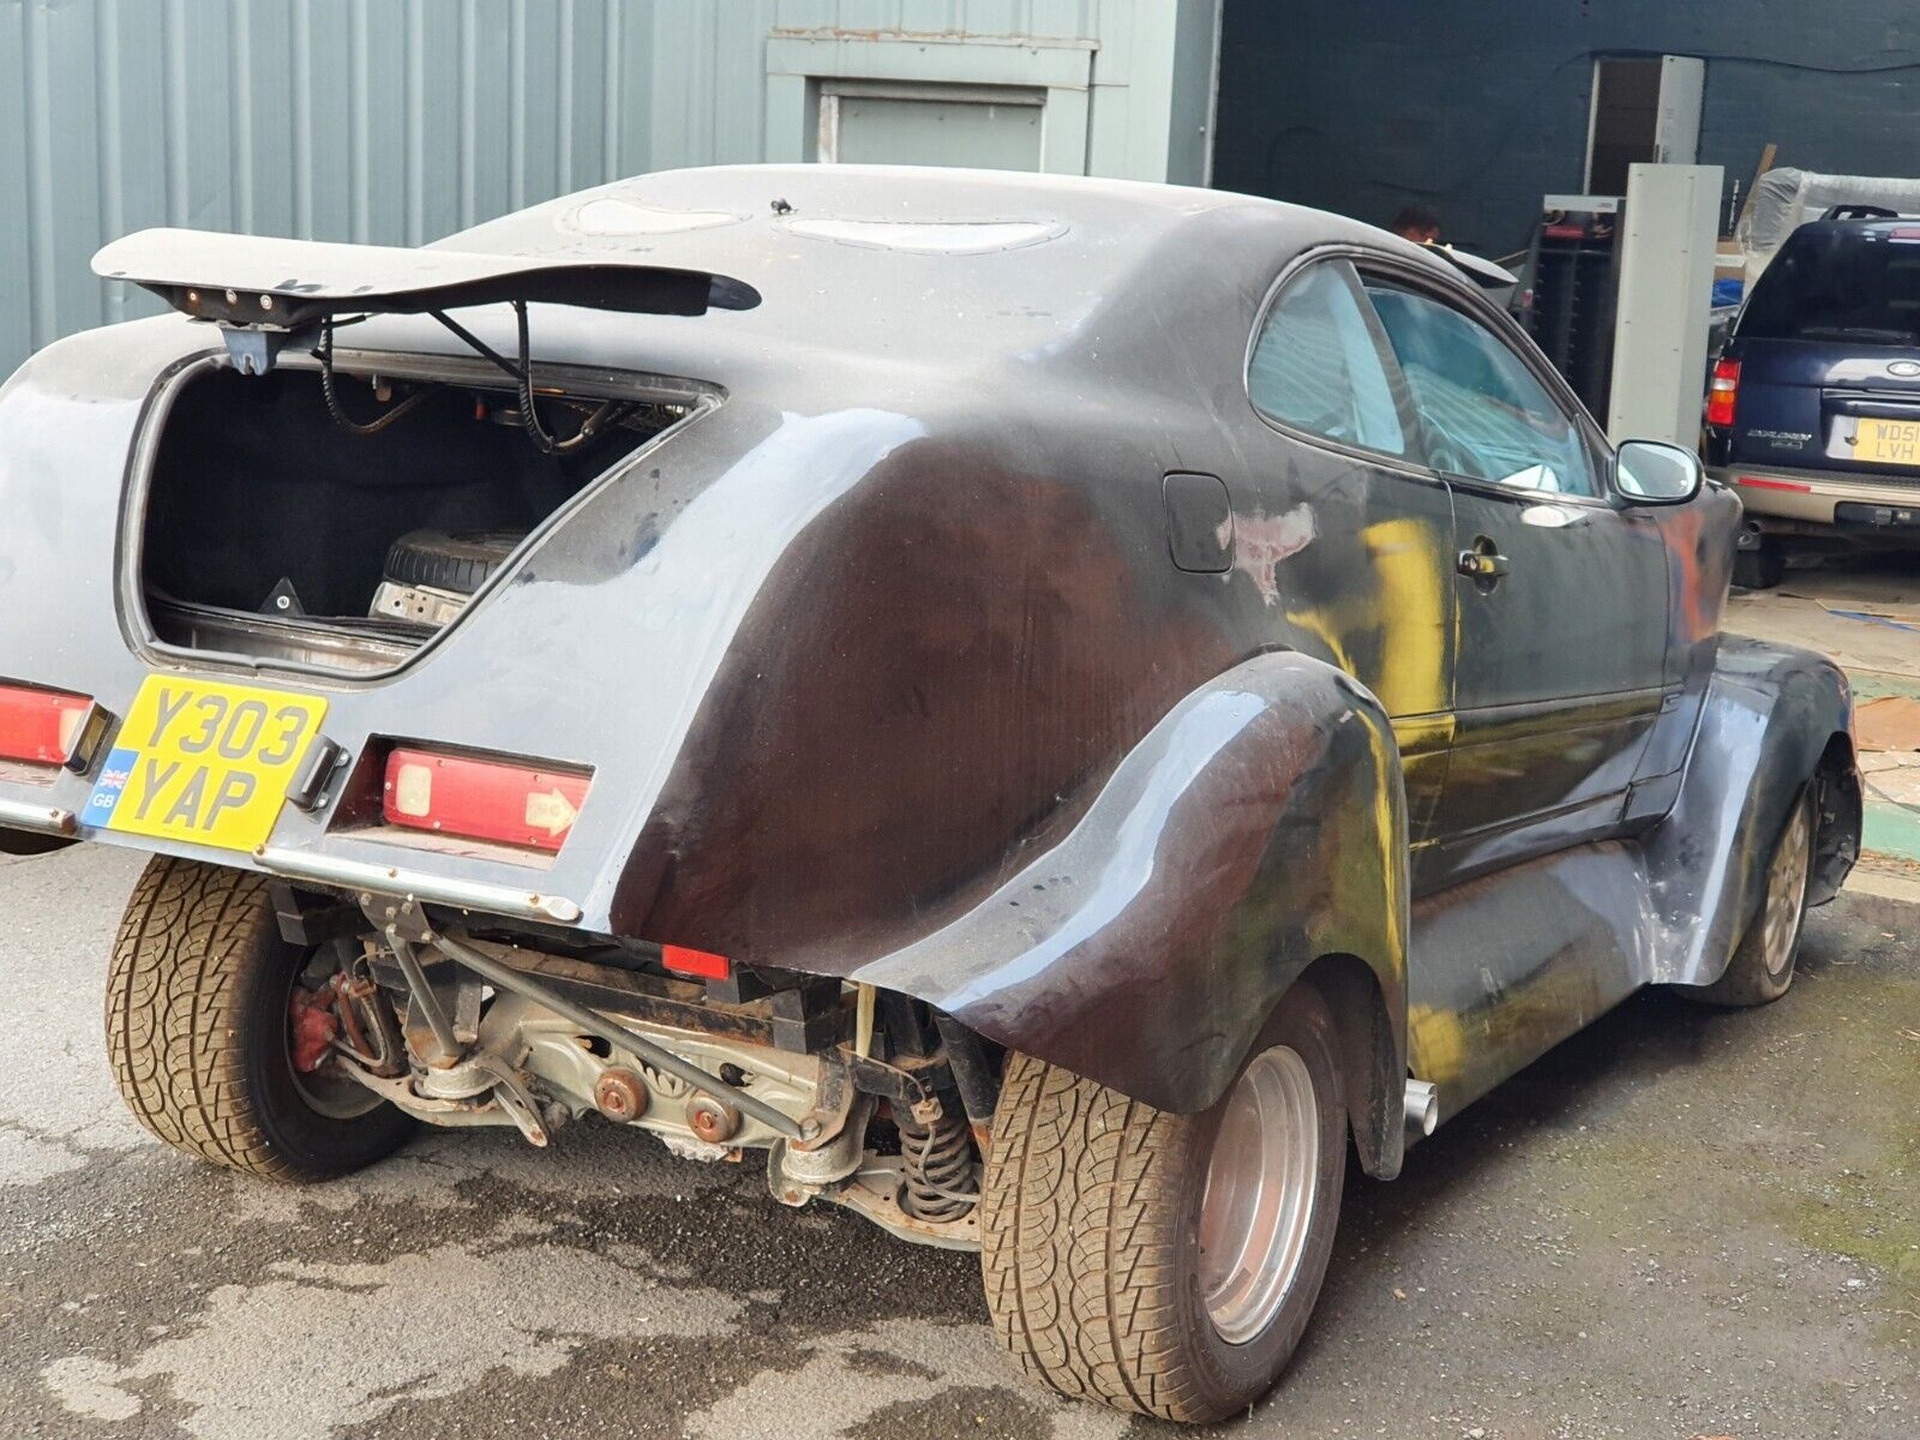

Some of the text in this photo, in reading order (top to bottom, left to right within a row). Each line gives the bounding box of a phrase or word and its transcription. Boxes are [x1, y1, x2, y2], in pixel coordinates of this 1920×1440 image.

[1876, 441, 1914, 459] LVH
[148, 688, 309, 765] Y303
[92, 793, 114, 808] GB
[135, 758, 256, 831] YAP
